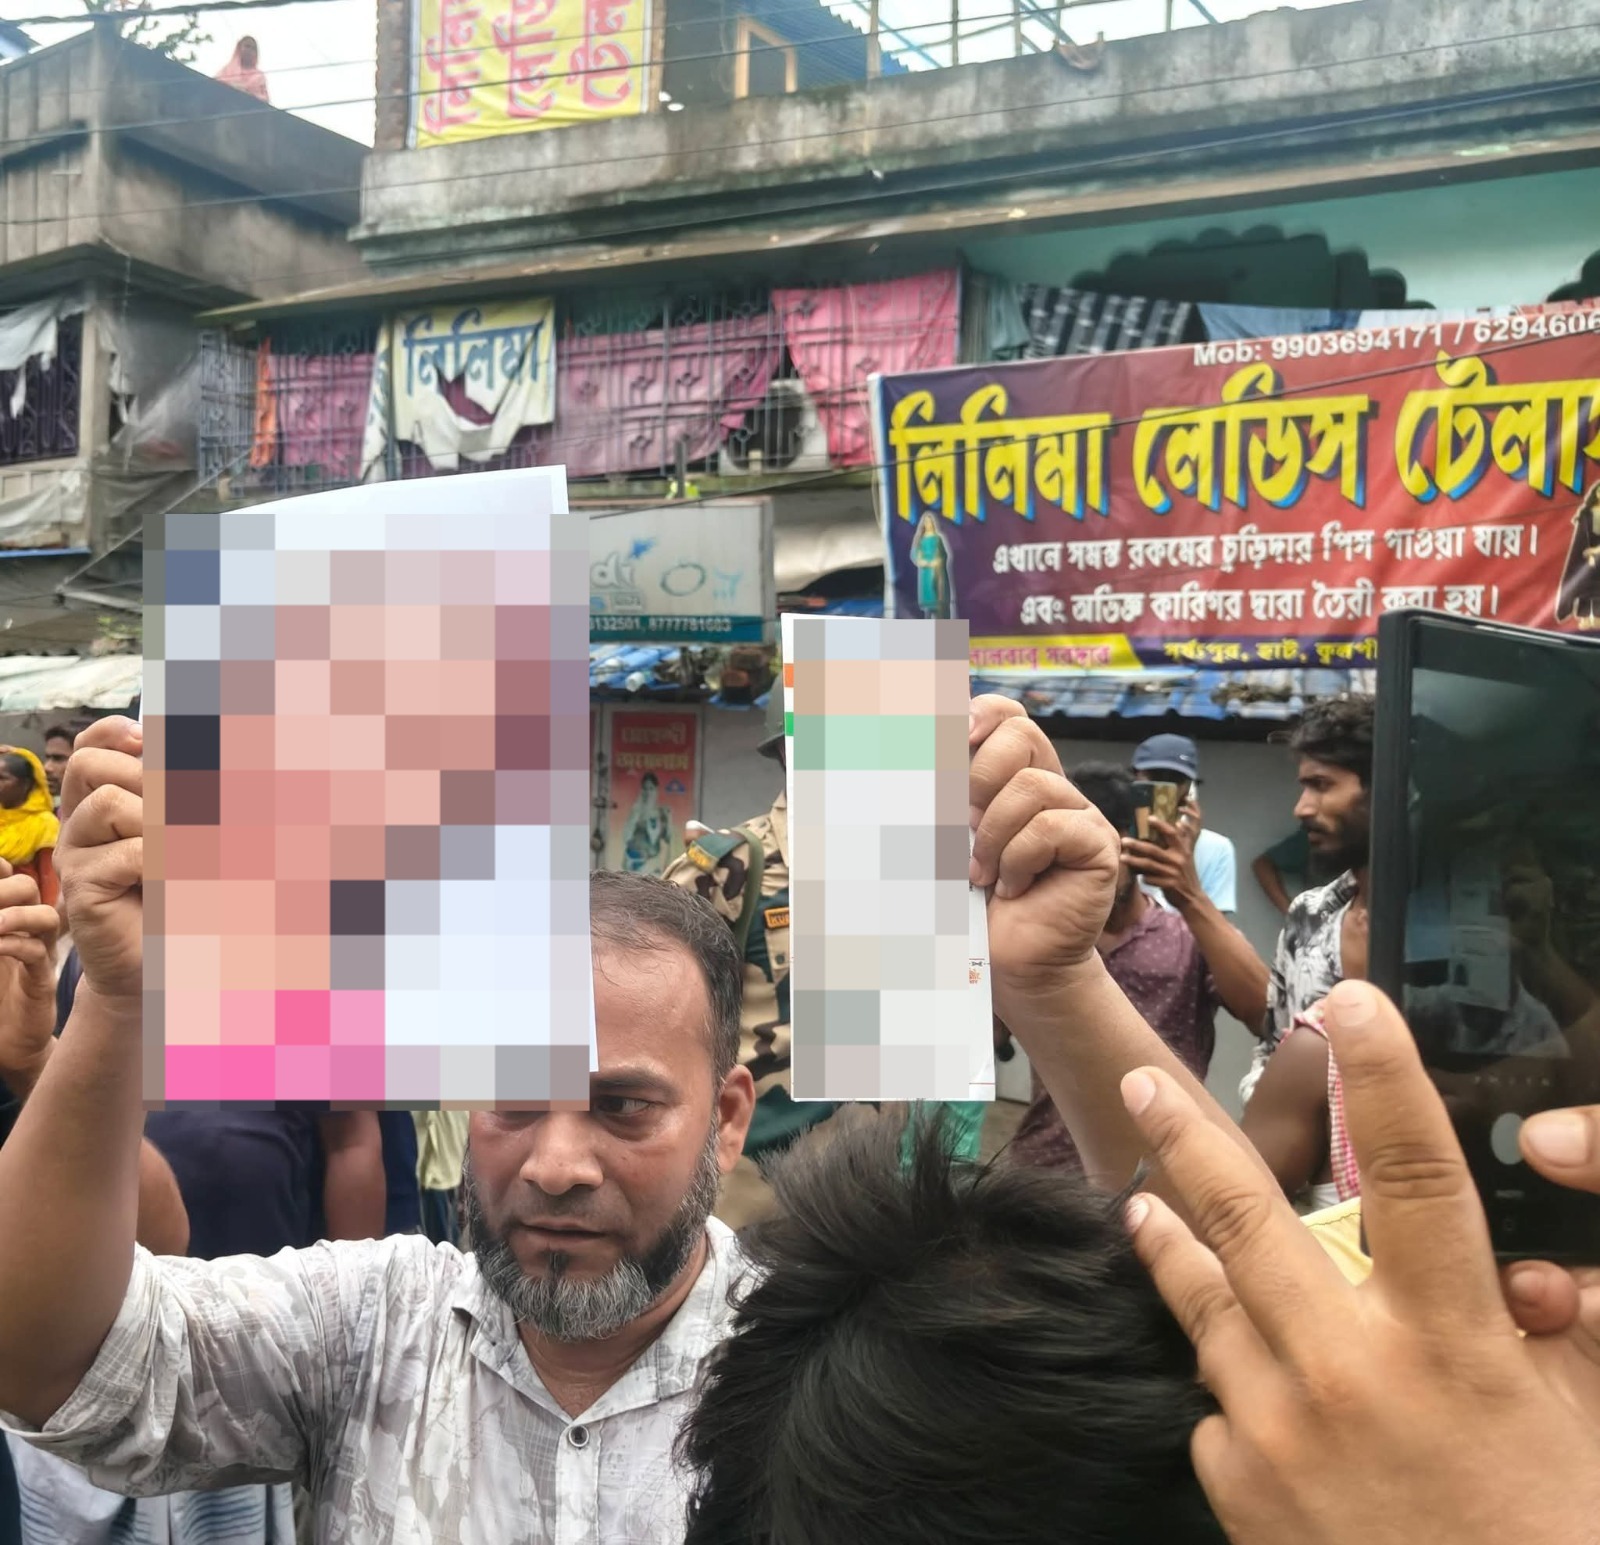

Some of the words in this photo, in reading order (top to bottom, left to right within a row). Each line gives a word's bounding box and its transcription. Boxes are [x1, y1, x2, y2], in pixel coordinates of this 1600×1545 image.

[424, 0, 481, 134] লিলি
[1194, 343, 1261, 366] Mob:
[1271, 322, 1444, 360] 9903694171
[1453, 322, 1466, 346] /
[889, 383, 1113, 524] লিলিমা
[1132, 362, 1371, 513] লেডিস
[993, 542, 1062, 573] এখানে
[1067, 539, 1122, 571] সমস্ত
[1127, 535, 1215, 571] রকমের
[1220, 523, 1315, 573] চুড়িদার
[1321, 520, 1375, 561] পিস
[1384, 527, 1466, 561] পাওয়া
[1020, 596, 1068, 624] এবং
[1149, 580, 1244, 621] কারিগর
[1312, 576, 1375, 619] তৈরী
